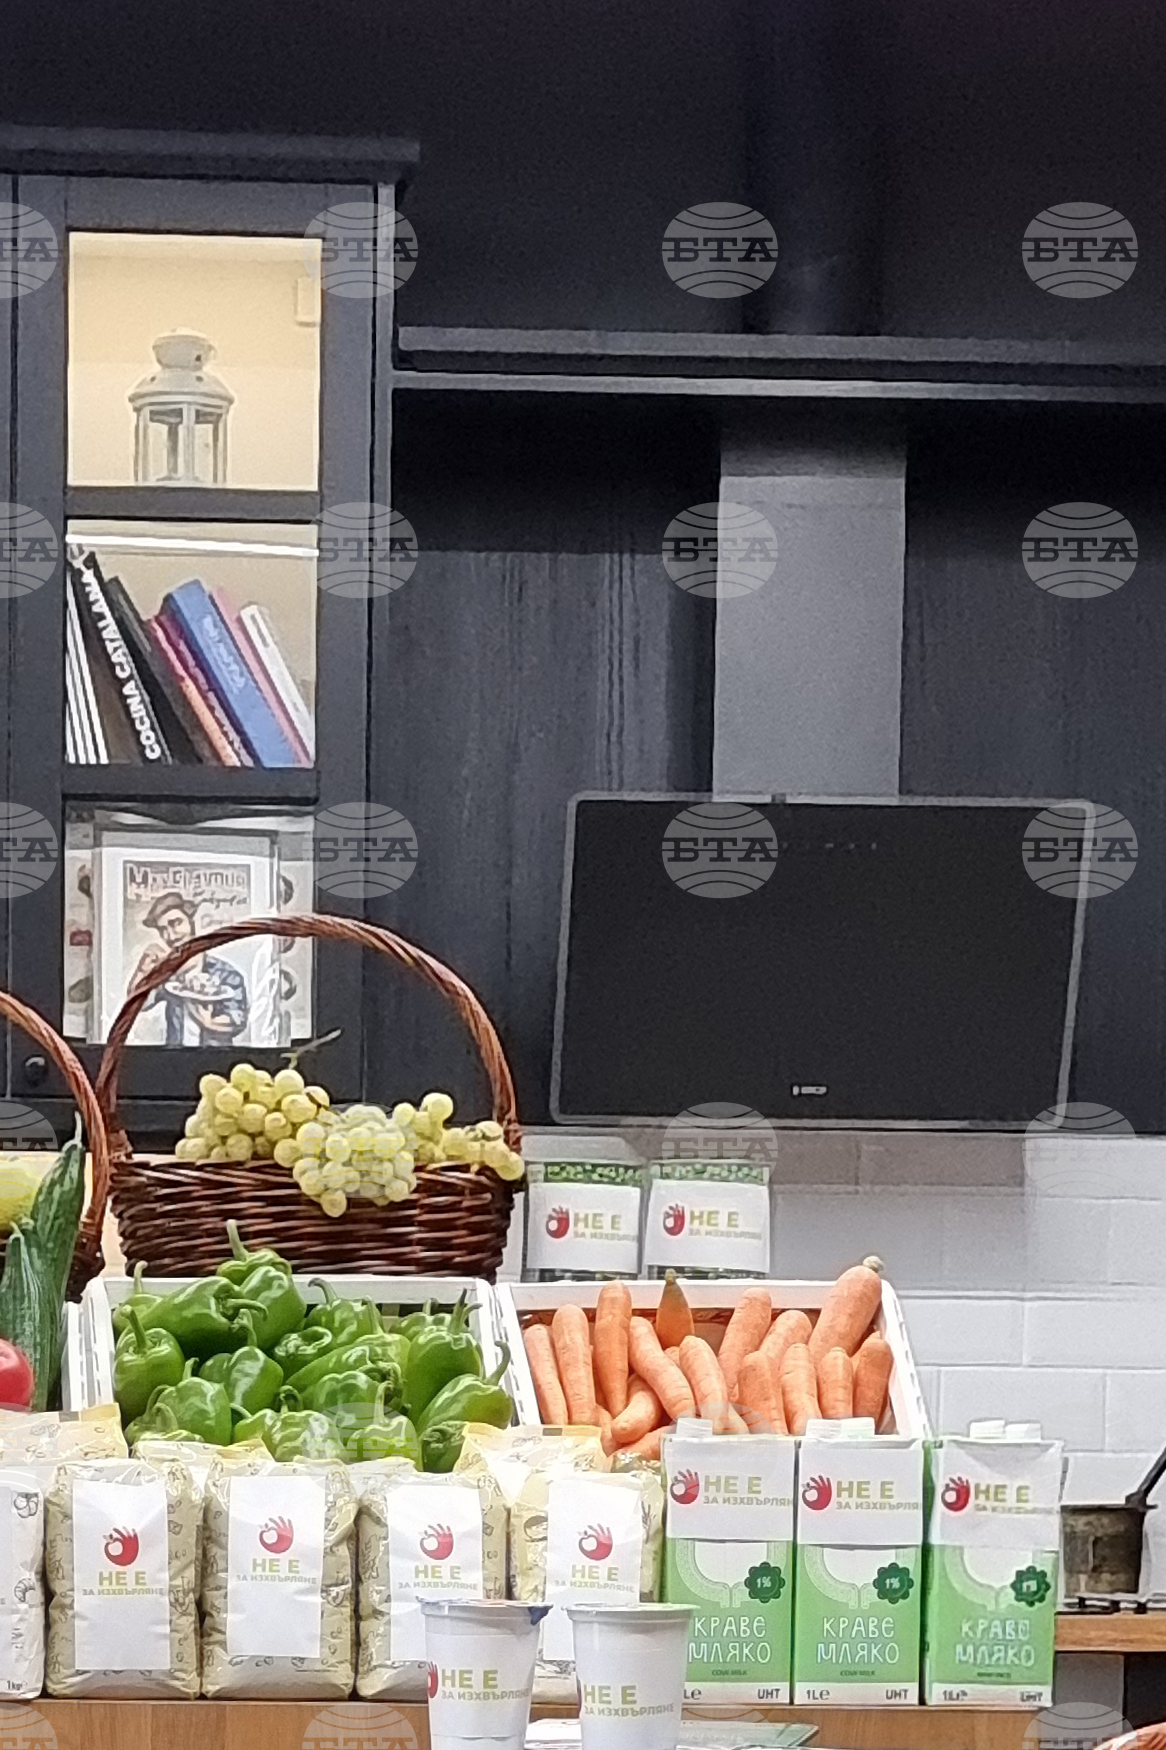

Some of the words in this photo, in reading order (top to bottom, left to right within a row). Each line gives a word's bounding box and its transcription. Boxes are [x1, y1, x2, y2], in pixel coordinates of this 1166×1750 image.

[82, 566, 132, 679] CATALANA
[122, 678, 162, 761] COCINA
[573, 1212, 604, 1230] НЕ
[610, 1214, 622, 1231] Е
[689, 1210, 720, 1228] НЕ
[727, 1211, 740, 1228] Е
[704, 1476, 739, 1494] НЕ
[748, 1477, 763, 1495] Е
[836, 1480, 871, 1499] НЕ
[880, 1481, 895, 1499] Е
[975, 1483, 1007, 1503] НЕ
[1016, 1485, 1031, 1504] Е
[703, 1496, 720, 1505] ЗА
[836, 1501, 852, 1510] ЗА
[252, 1558, 280, 1573] НЕ
[288, 1559, 299, 1574] Е
[415, 1565, 443, 1579] НЕ
[450, 1566, 461, 1580] Е
[571, 1564, 600, 1580] НЕ
[607, 1566, 619, 1582] Е
[98, 1571, 127, 1586] НЕ
[135, 1571, 147, 1586] Е
[236, 1574, 248, 1582] ЗА
[755, 1576, 772, 1589] 1%
[884, 1577, 901, 1589] 1%
[82, 1588, 94, 1596] ЗА
[694, 1616, 766, 1638] КРАВЕ
[823, 1616, 895, 1638] КРАВЕ
[688, 1642, 772, 1664] МЛЯКО
[817, 1643, 900, 1664] МЛЯКО
[955, 1643, 1034, 1667] МЛЯКО
[441, 1669, 474, 1690] НЕ
[483, 1669, 498, 1690] Е
[441, 1690, 455, 1699] ЗА
[583, 1685, 612, 1705] НЕ
[621, 1685, 637, 1705] Е
[757, 1688, 781, 1700] UHT
[885, 1688, 909, 1700] UHT
[584, 1705, 595, 1714] ЗА
